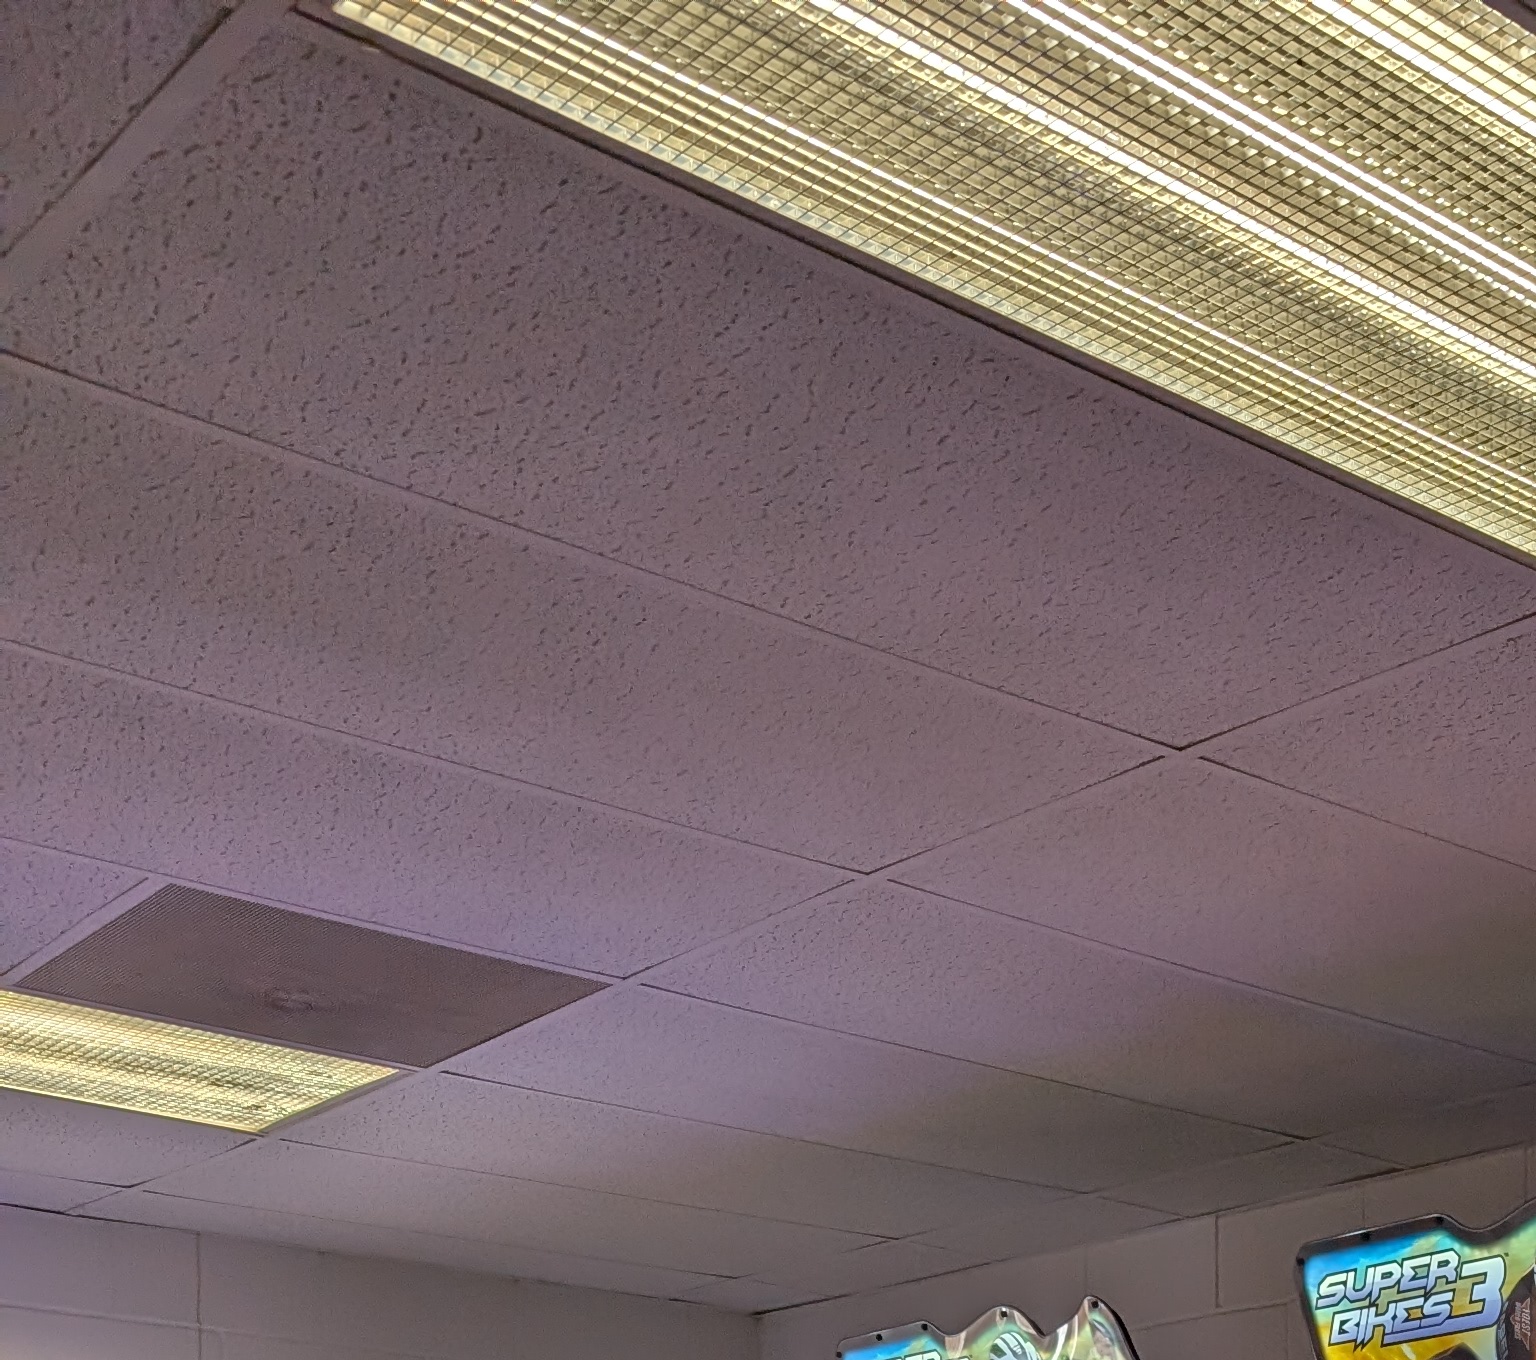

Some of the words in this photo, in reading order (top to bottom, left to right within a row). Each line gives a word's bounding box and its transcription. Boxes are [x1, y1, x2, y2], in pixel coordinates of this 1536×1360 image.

[1315, 1249, 1461, 1308] SUPER
[1329, 1292, 1454, 1351] BIKES
[1453, 1255, 1506, 1340] 3
